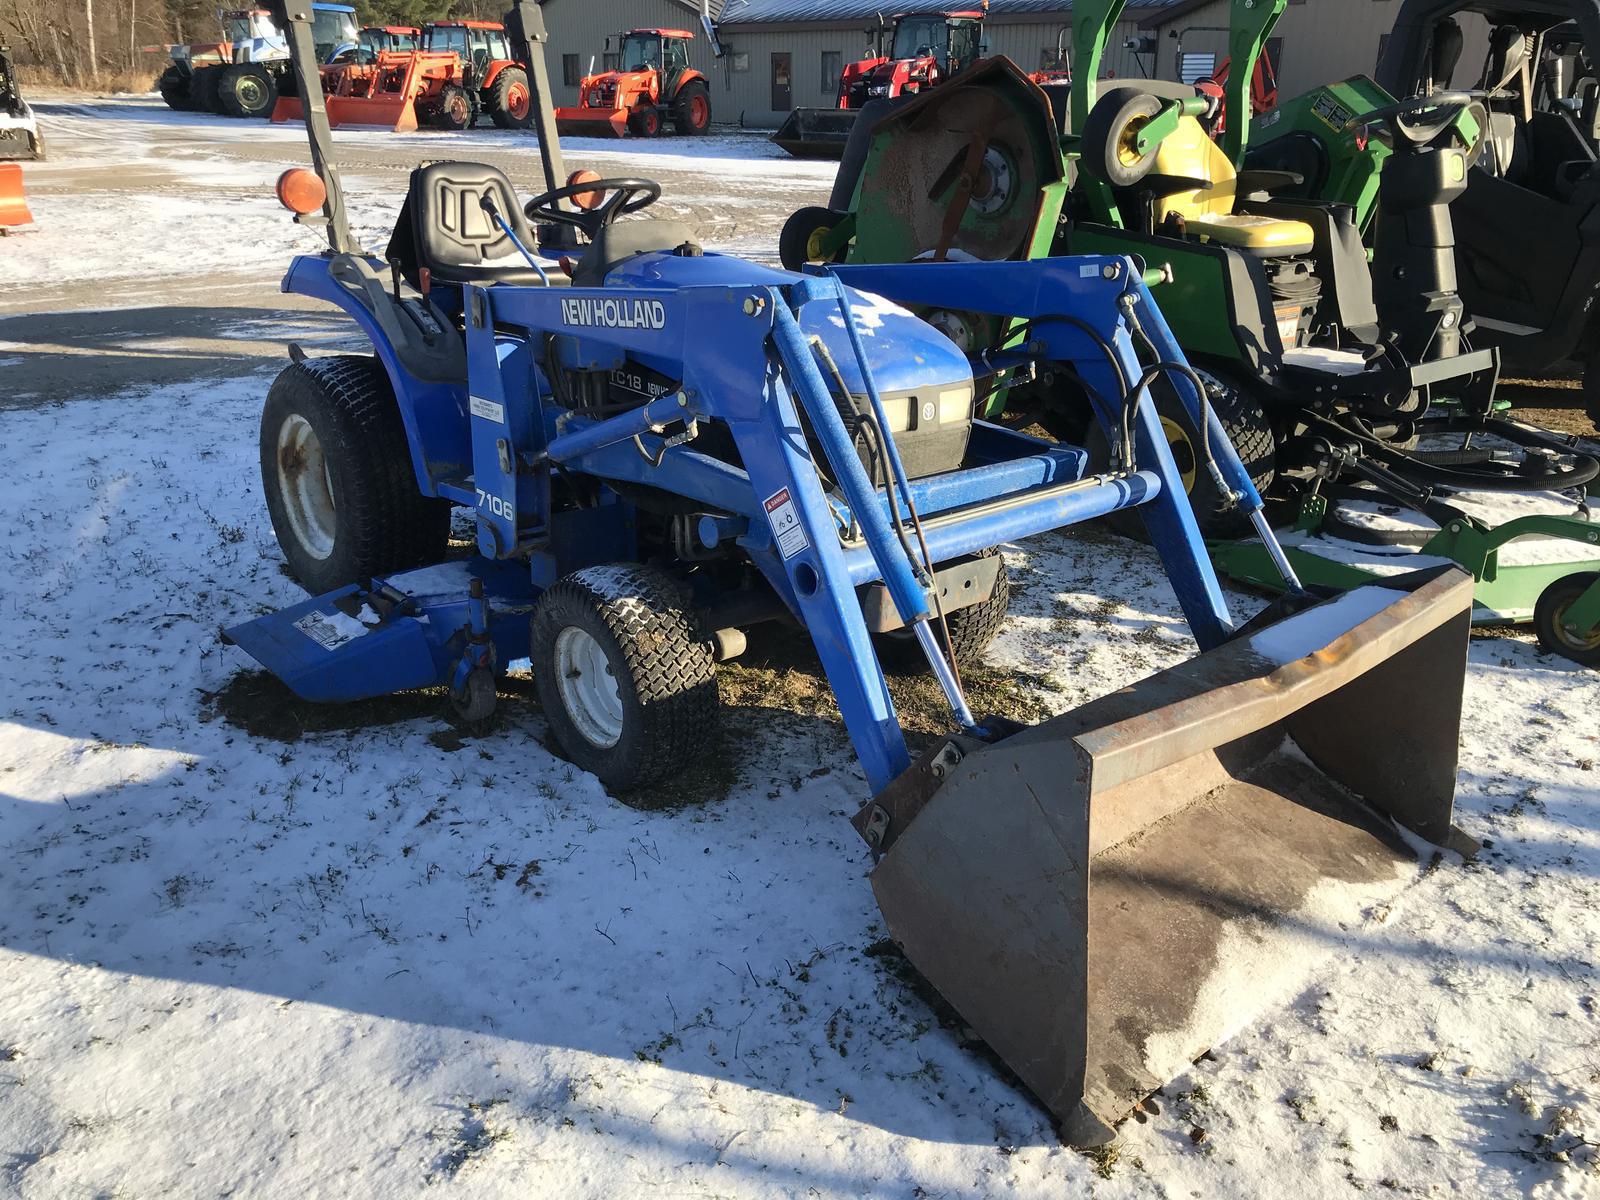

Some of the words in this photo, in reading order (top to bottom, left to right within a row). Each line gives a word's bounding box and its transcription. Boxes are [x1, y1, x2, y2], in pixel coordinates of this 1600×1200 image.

[561, 299, 592, 326] NEW
[593, 299, 665, 329] HOLLAND
[611, 370, 642, 390] TC18
[647, 382, 660, 396] NEW
[476, 488, 513, 521] 7106
[771, 492, 788, 507] DANGER
